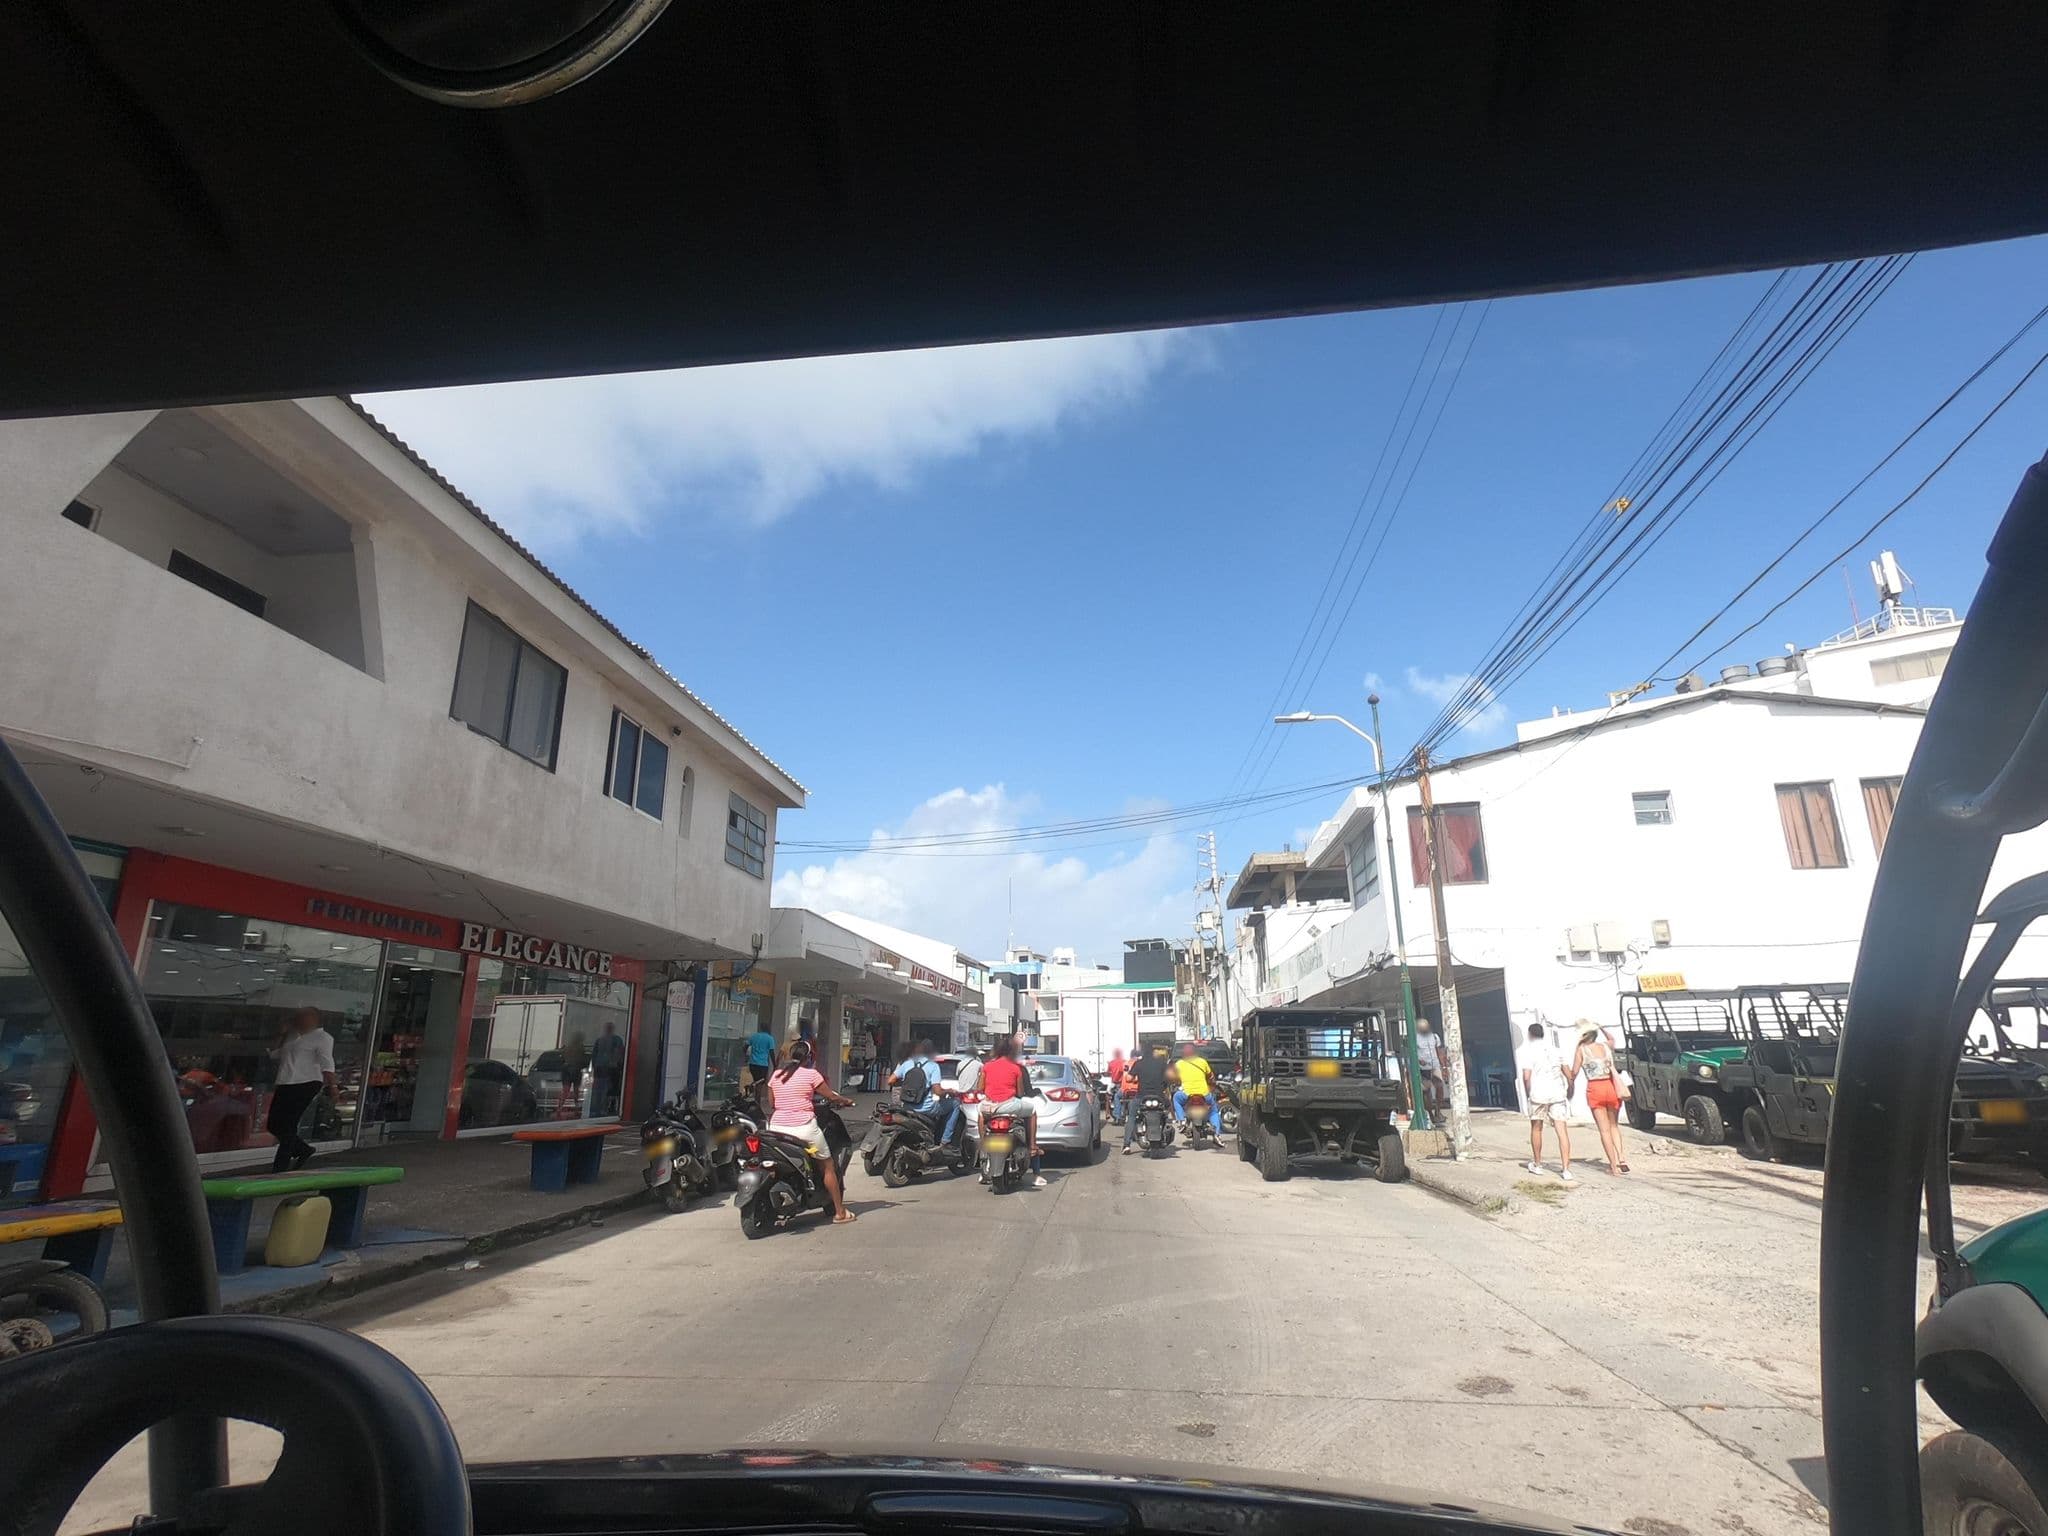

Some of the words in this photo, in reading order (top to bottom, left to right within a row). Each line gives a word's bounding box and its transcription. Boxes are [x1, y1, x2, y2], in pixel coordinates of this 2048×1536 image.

[460, 922, 613, 976] ELEGANCE
[940, 979, 962, 997] PLAZA
[1640, 977, 1652, 988] SE
[1653, 975, 1686, 988] ALQUILA
